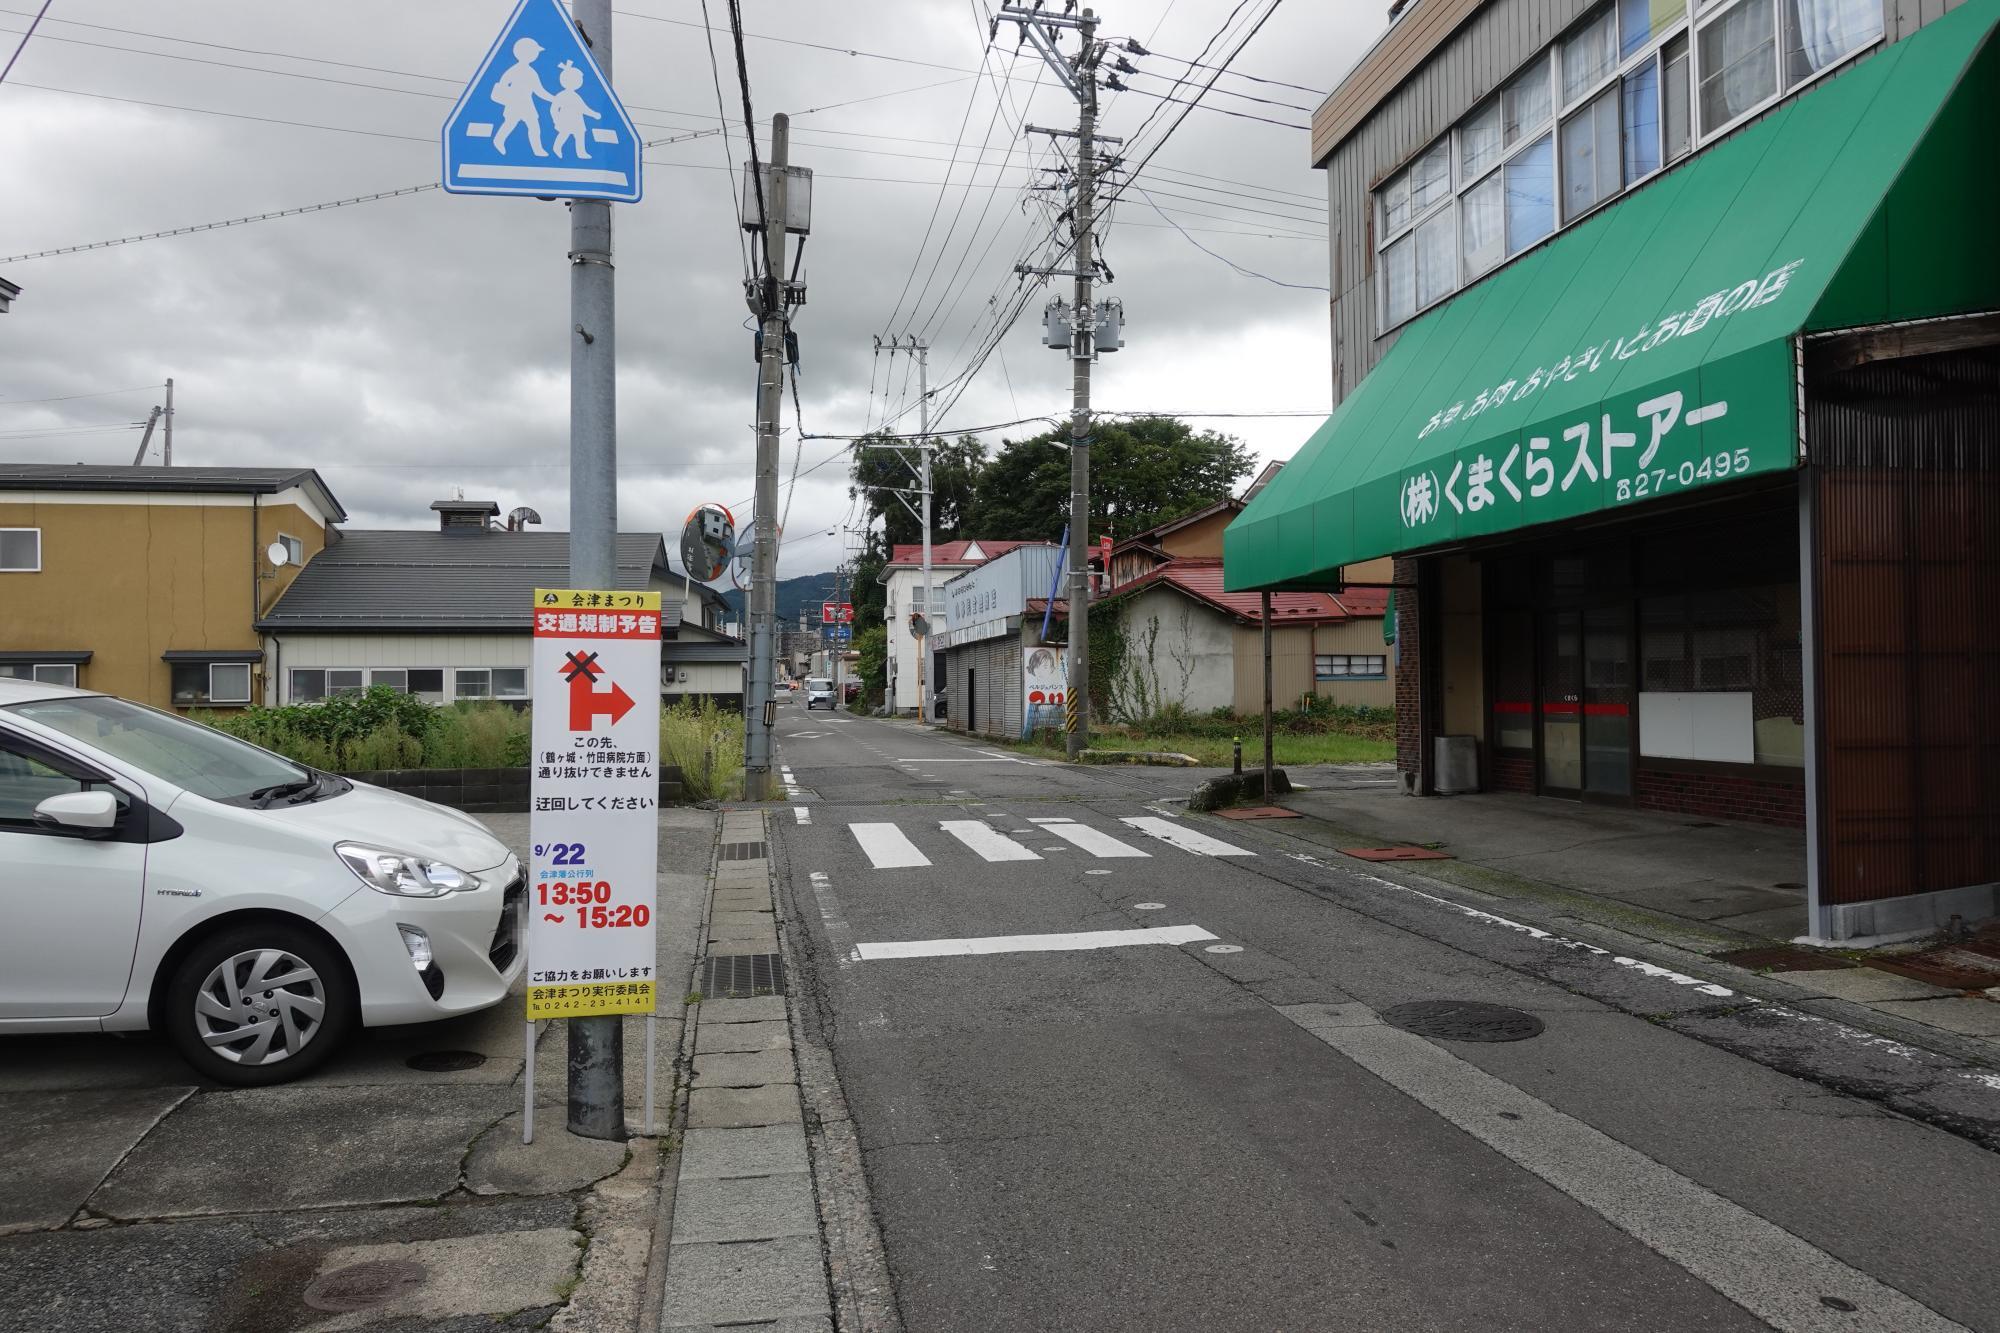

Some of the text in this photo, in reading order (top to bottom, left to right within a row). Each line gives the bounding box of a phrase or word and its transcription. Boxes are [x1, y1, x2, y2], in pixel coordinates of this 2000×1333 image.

[1635, 447, 1751, 497] 27-0495
[571, 593, 646, 609] 会津まつり
[537, 613, 657, 634] 交通規制予告
[574, 736, 619, 749] この先、
[538, 766, 653, 779] 通り抜けできません
[535, 796, 655, 812] 迂回してください
[534, 843, 586, 865] 9/22
[537, 880, 612, 906] 13:50
[532, 966, 652, 982] ご協力をお願いします
[532, 983, 650, 1000] 会津まつり実行委員会
